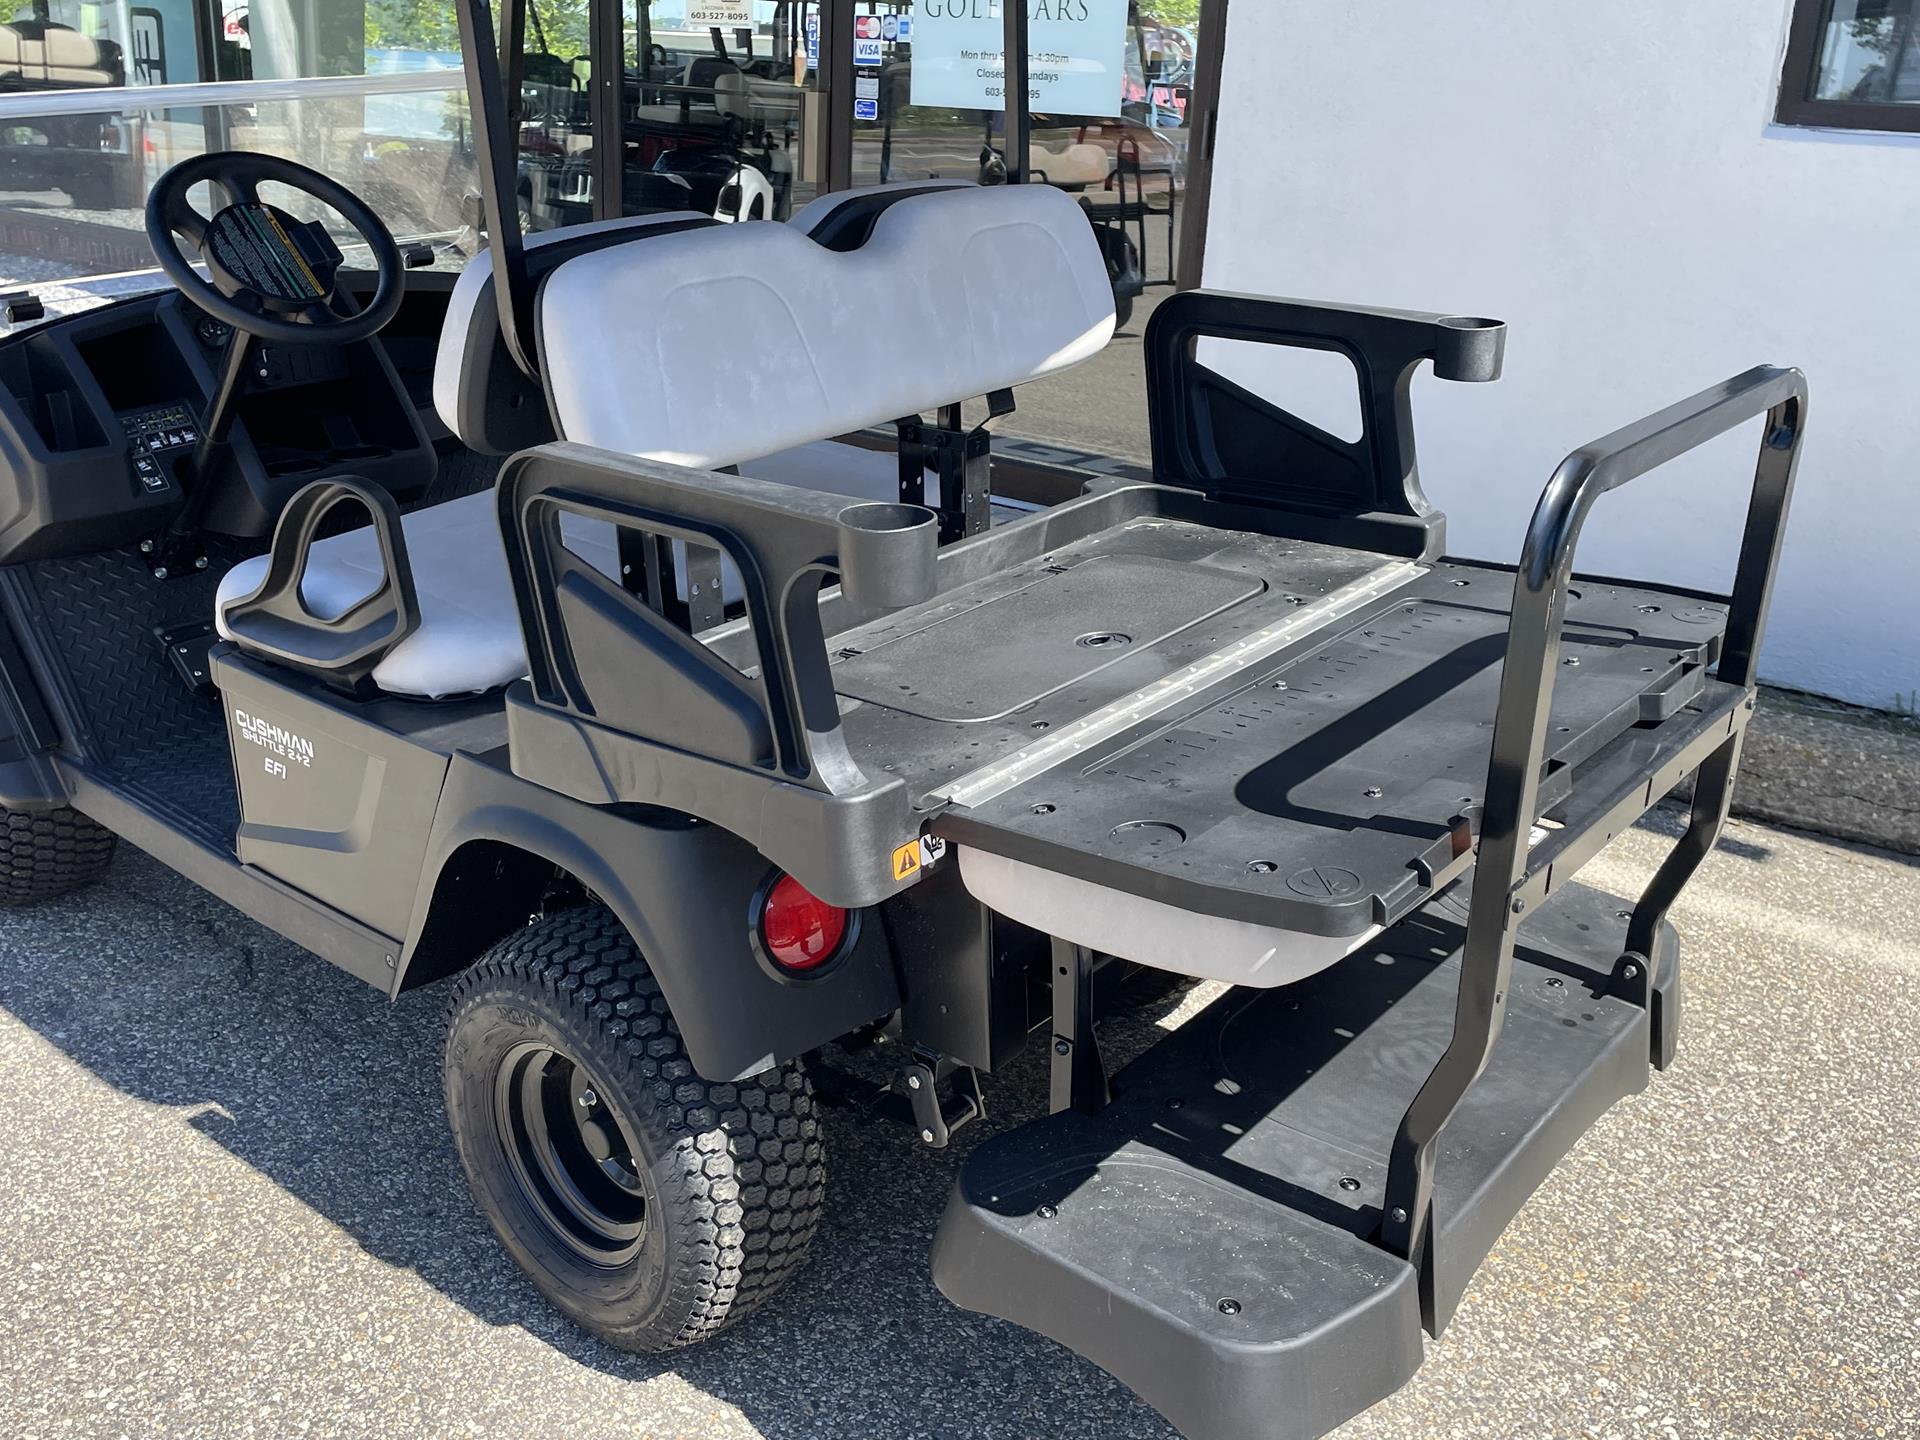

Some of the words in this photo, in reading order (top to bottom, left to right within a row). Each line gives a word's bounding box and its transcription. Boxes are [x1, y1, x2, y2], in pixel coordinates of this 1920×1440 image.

[690, 11, 749, 21] 603-527-8095
[1028, 0, 1089, 22] ARS
[808, 23, 817, 59] PULL
[858, 44, 880, 56] VISA
[961, 50, 978, 60] Mon
[980, 50, 998, 61] thru
[1027, 71, 1059, 83] undays
[235, 709, 315, 758] CUSHMAN
[242, 727, 286, 756] SHUTTLE
[288, 748, 311, 768] 2+2
[264, 757, 287, 780] EFI
